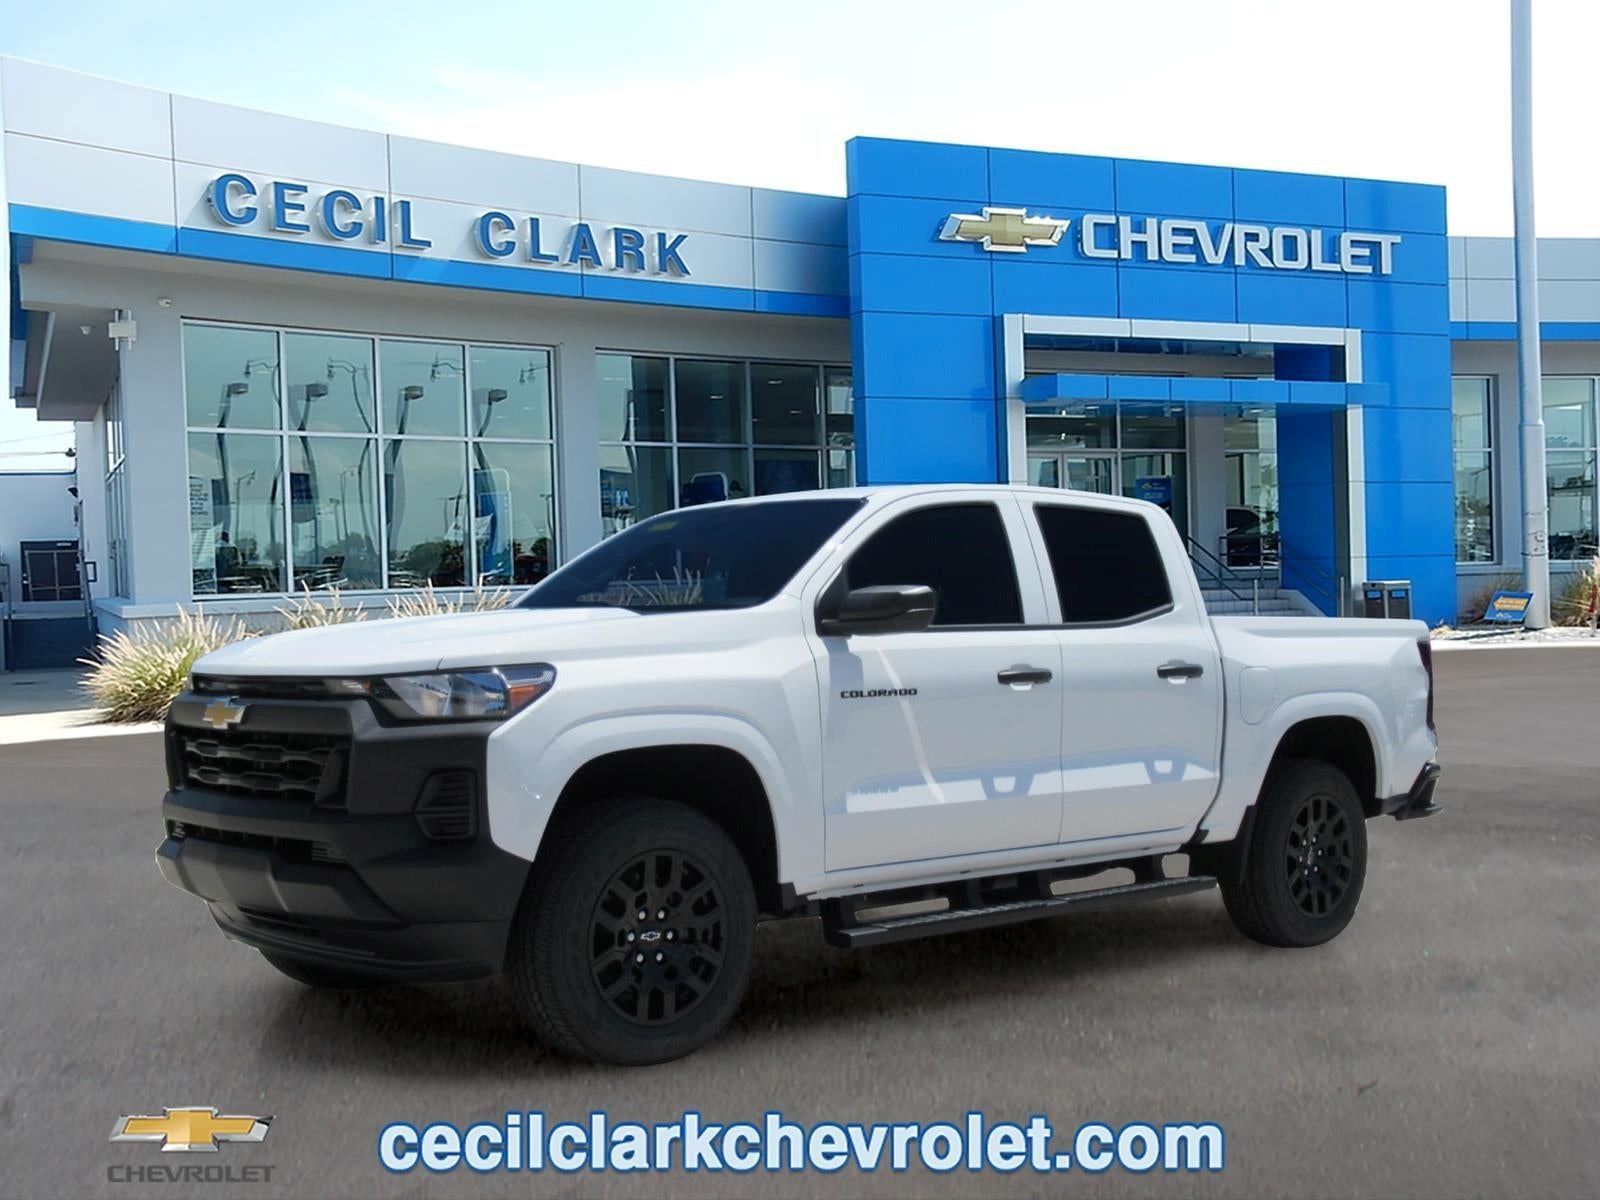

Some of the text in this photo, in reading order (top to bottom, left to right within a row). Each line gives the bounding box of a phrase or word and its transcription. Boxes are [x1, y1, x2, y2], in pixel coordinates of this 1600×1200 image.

[208, 173, 691, 277] CECIL CLARK
[1080, 214, 1402, 275] CHEVROLET
[841, 688, 917, 698] COLORADO
